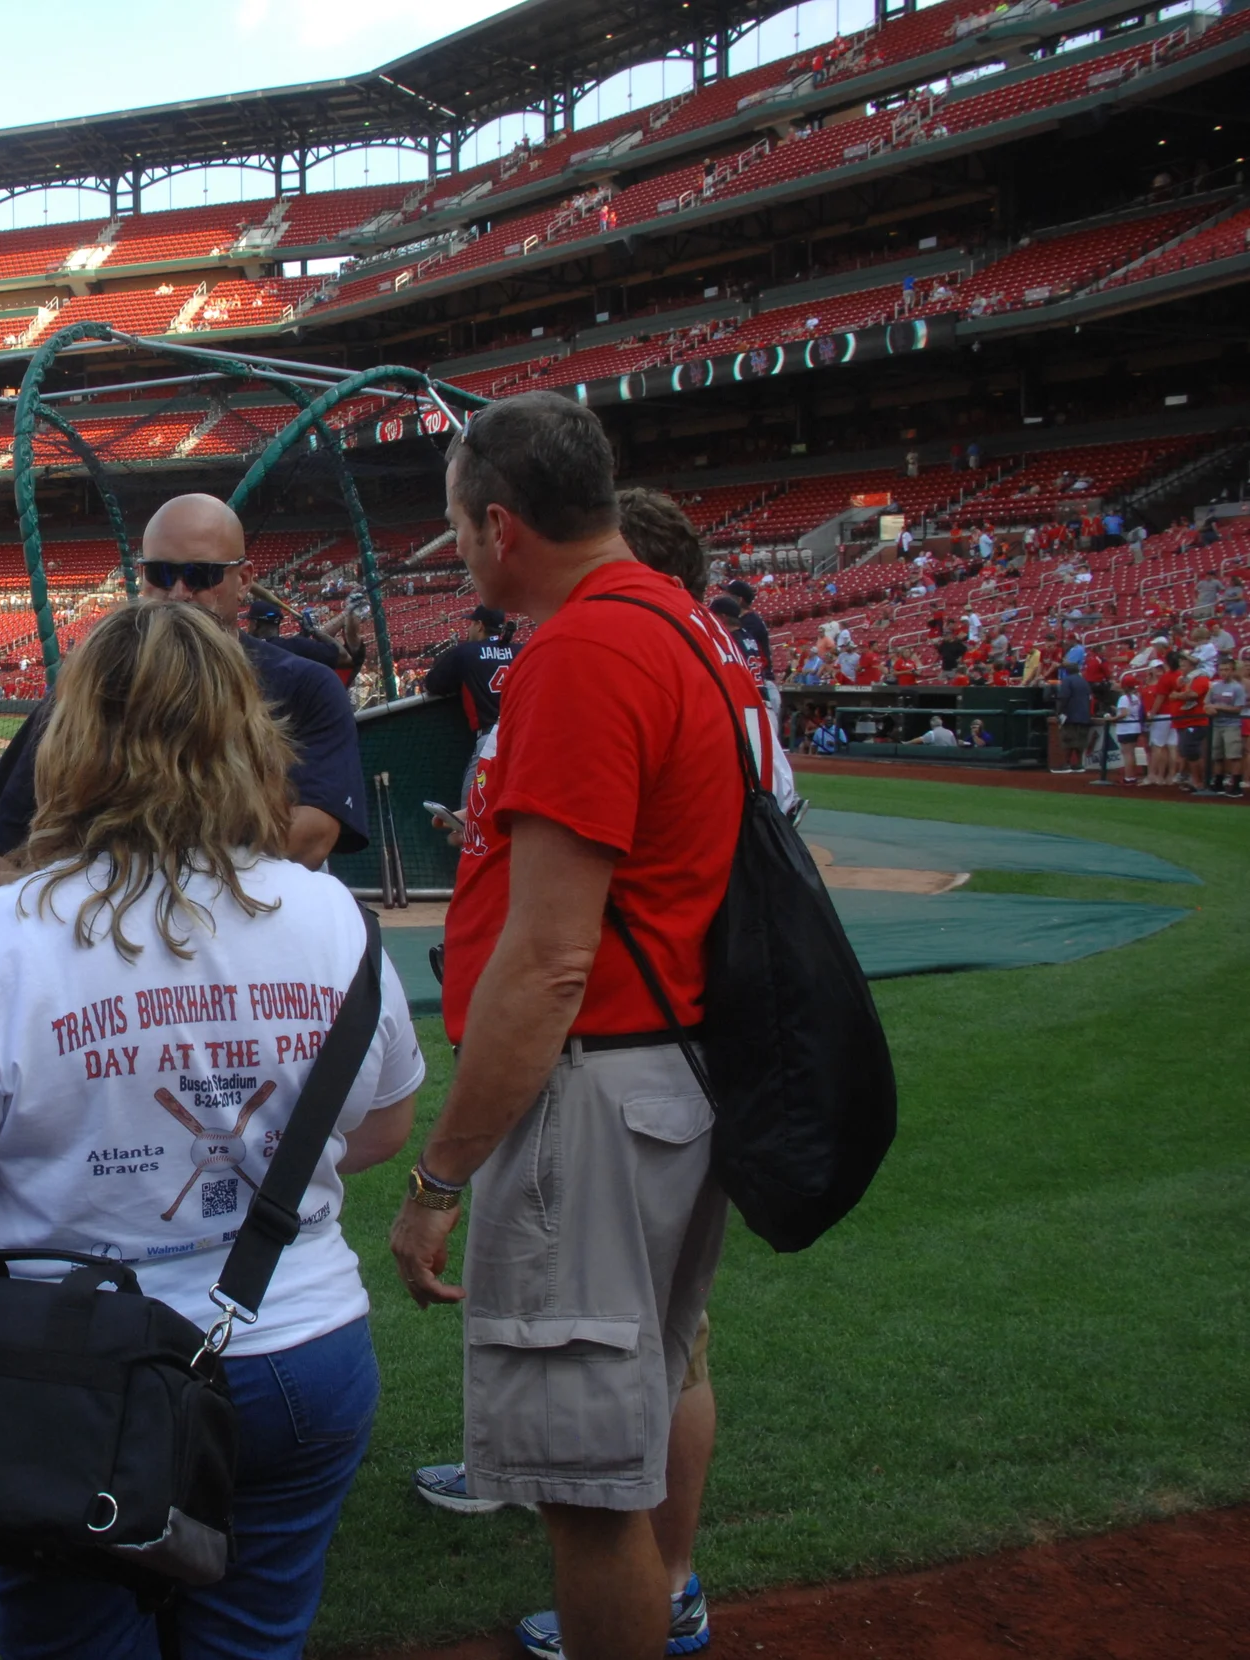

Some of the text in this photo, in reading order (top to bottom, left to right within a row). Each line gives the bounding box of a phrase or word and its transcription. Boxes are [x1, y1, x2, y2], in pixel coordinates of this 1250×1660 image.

[52, 996, 128, 1056] TRAVIS
[135, 984, 238, 1030] BURKHART
[84, 1030, 329, 1080] DAY AT THE PAR
[179, 1073, 257, 1093] Busch Stadium
[86, 1144, 165, 1163] Atlanta
[207, 1145, 229, 1155] vs
[93, 1161, 159, 1177] Braves
[147, 1242, 194, 1256] Walmart
